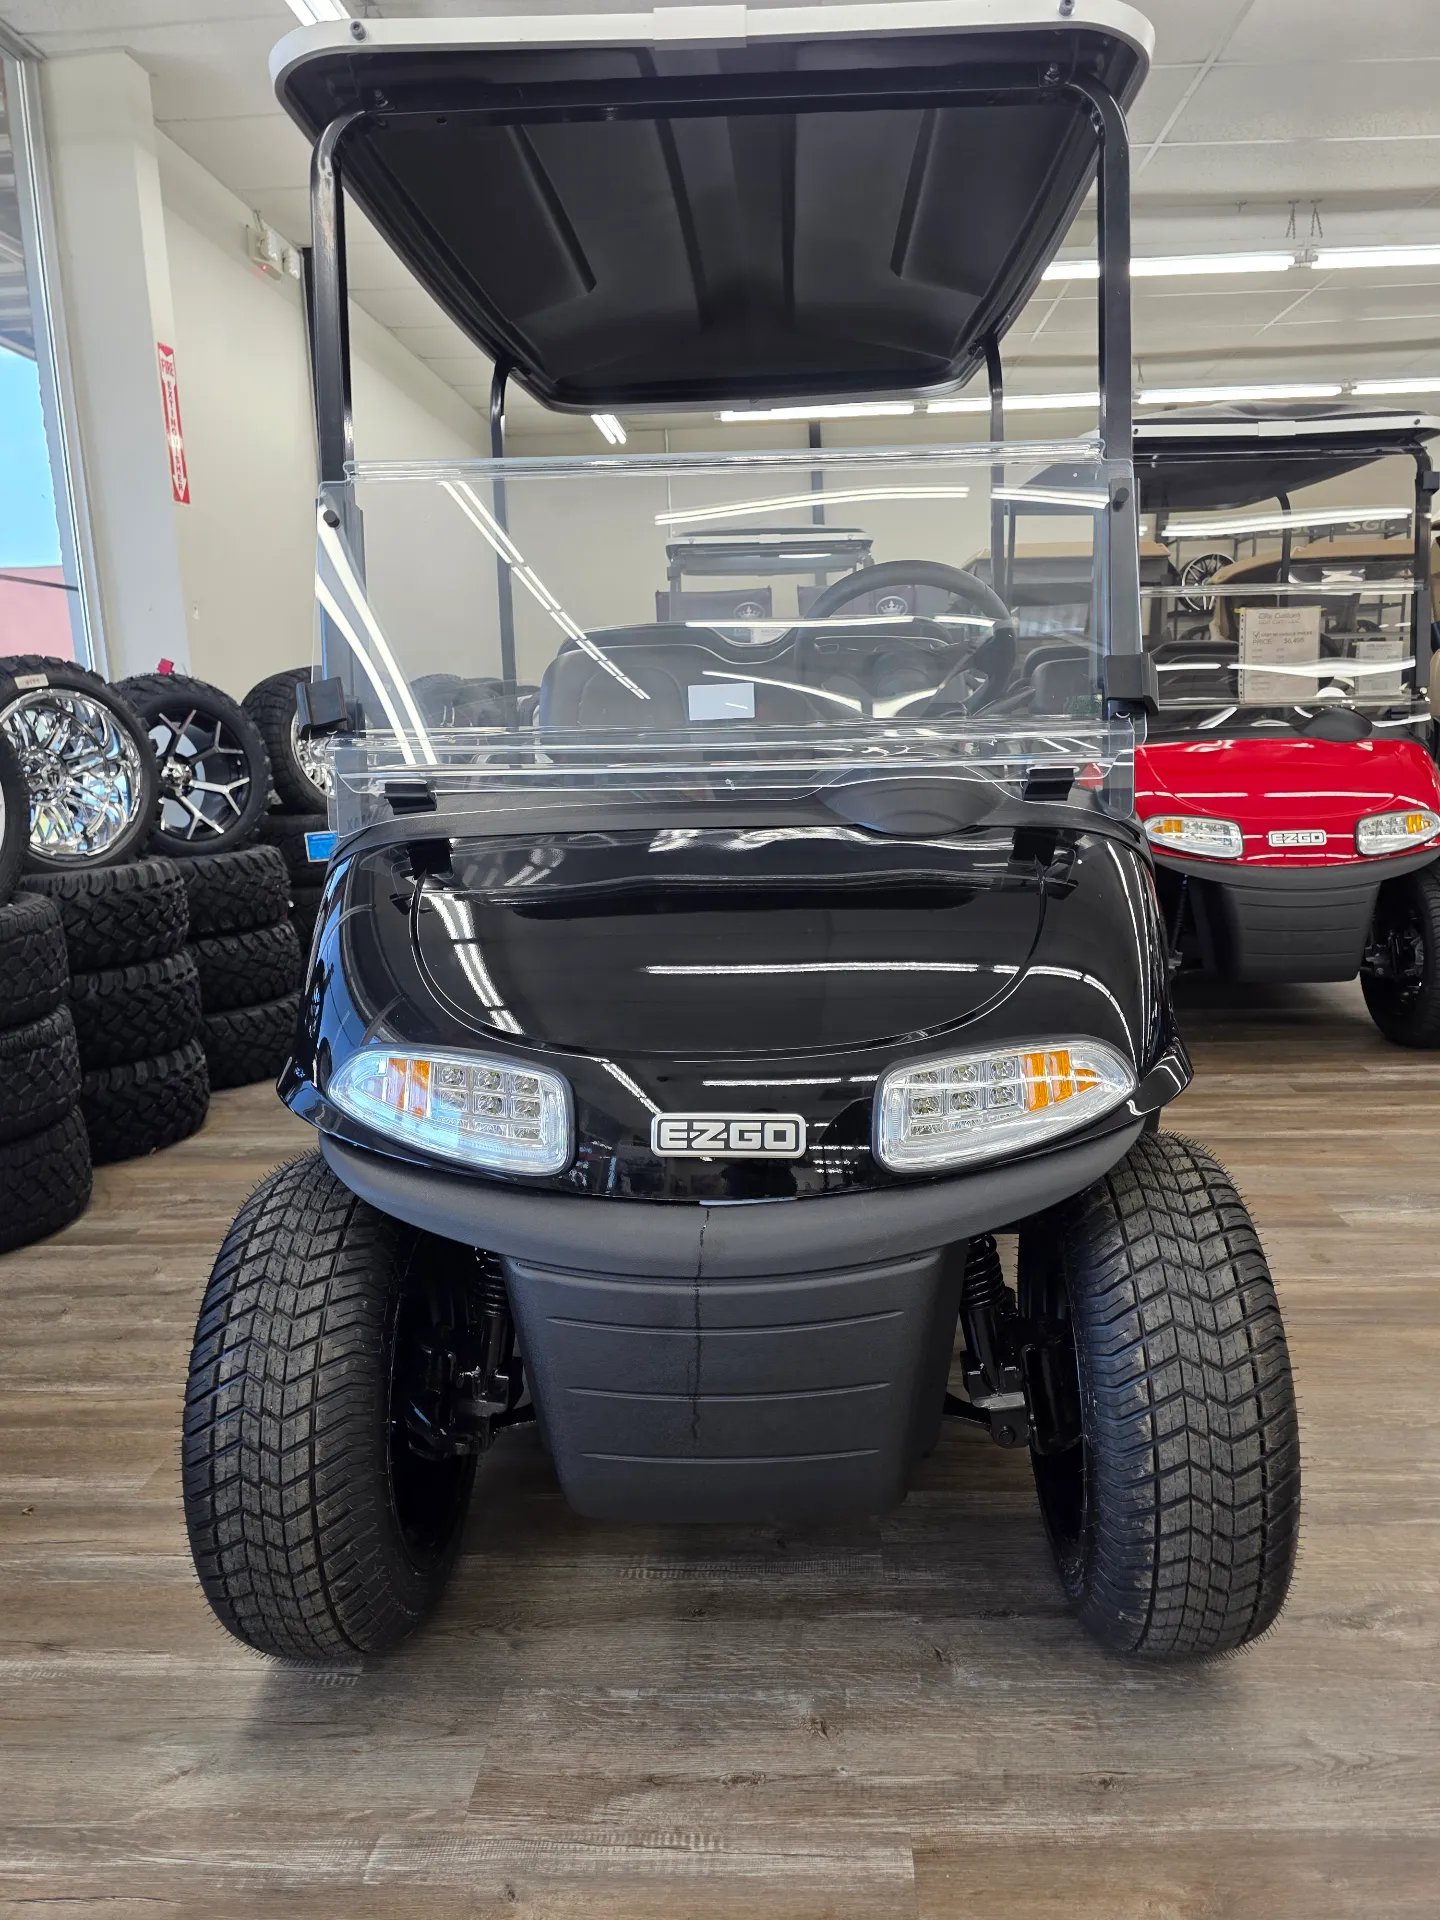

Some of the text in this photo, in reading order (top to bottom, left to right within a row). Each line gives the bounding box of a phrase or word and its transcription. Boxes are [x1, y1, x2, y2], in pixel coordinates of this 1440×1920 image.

[160, 358, 175, 377] FIRE
[166, 381, 184, 491] EXTINGUISHER
[1271, 832, 1324, 845] EZGO
[660, 1121, 796, 1150] EZGO
